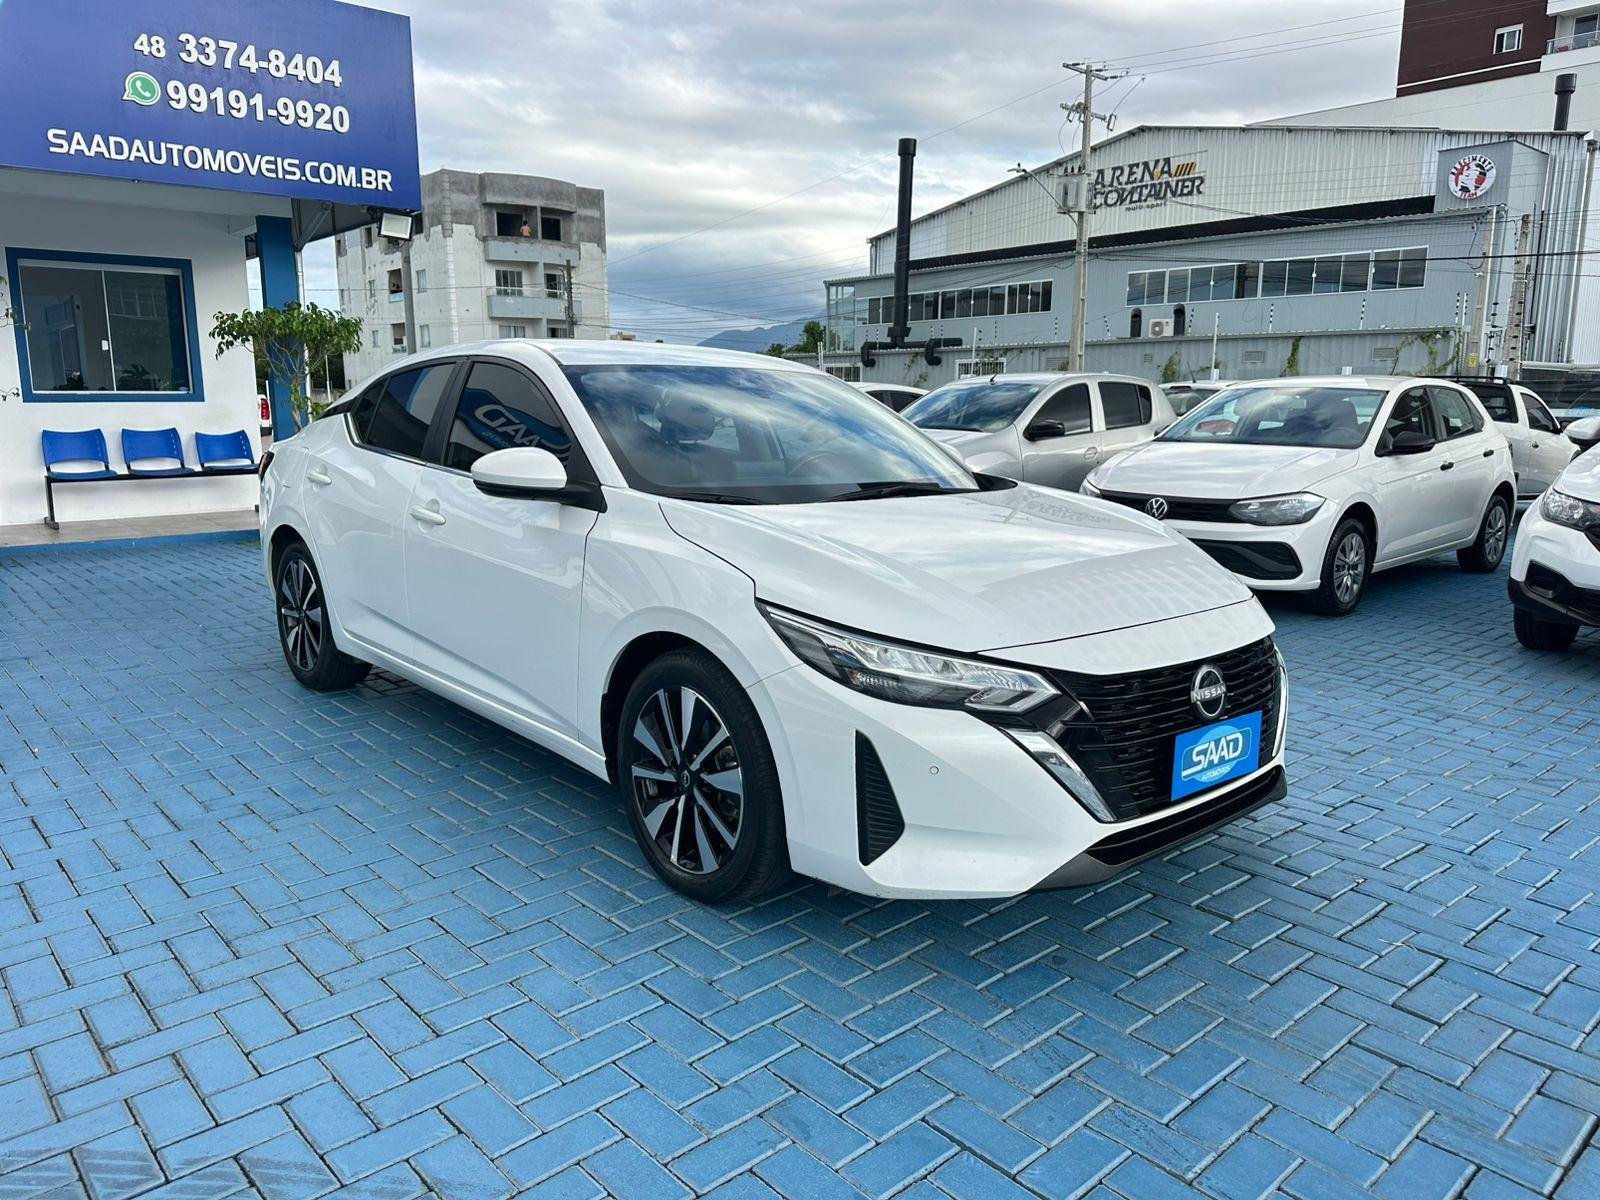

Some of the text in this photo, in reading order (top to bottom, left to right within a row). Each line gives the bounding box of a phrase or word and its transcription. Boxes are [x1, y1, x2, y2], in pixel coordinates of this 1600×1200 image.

[133, 33, 343, 88] 48 3374-8404
[166, 80, 351, 133] 99191-9920
[47, 128, 393, 192] SAADAUTOMOVEIS.COM.BR
[1094, 157, 1173, 188] ARENA
[1192, 684, 1226, 700] NISSAN
[1182, 732, 1243, 777] SAAD
